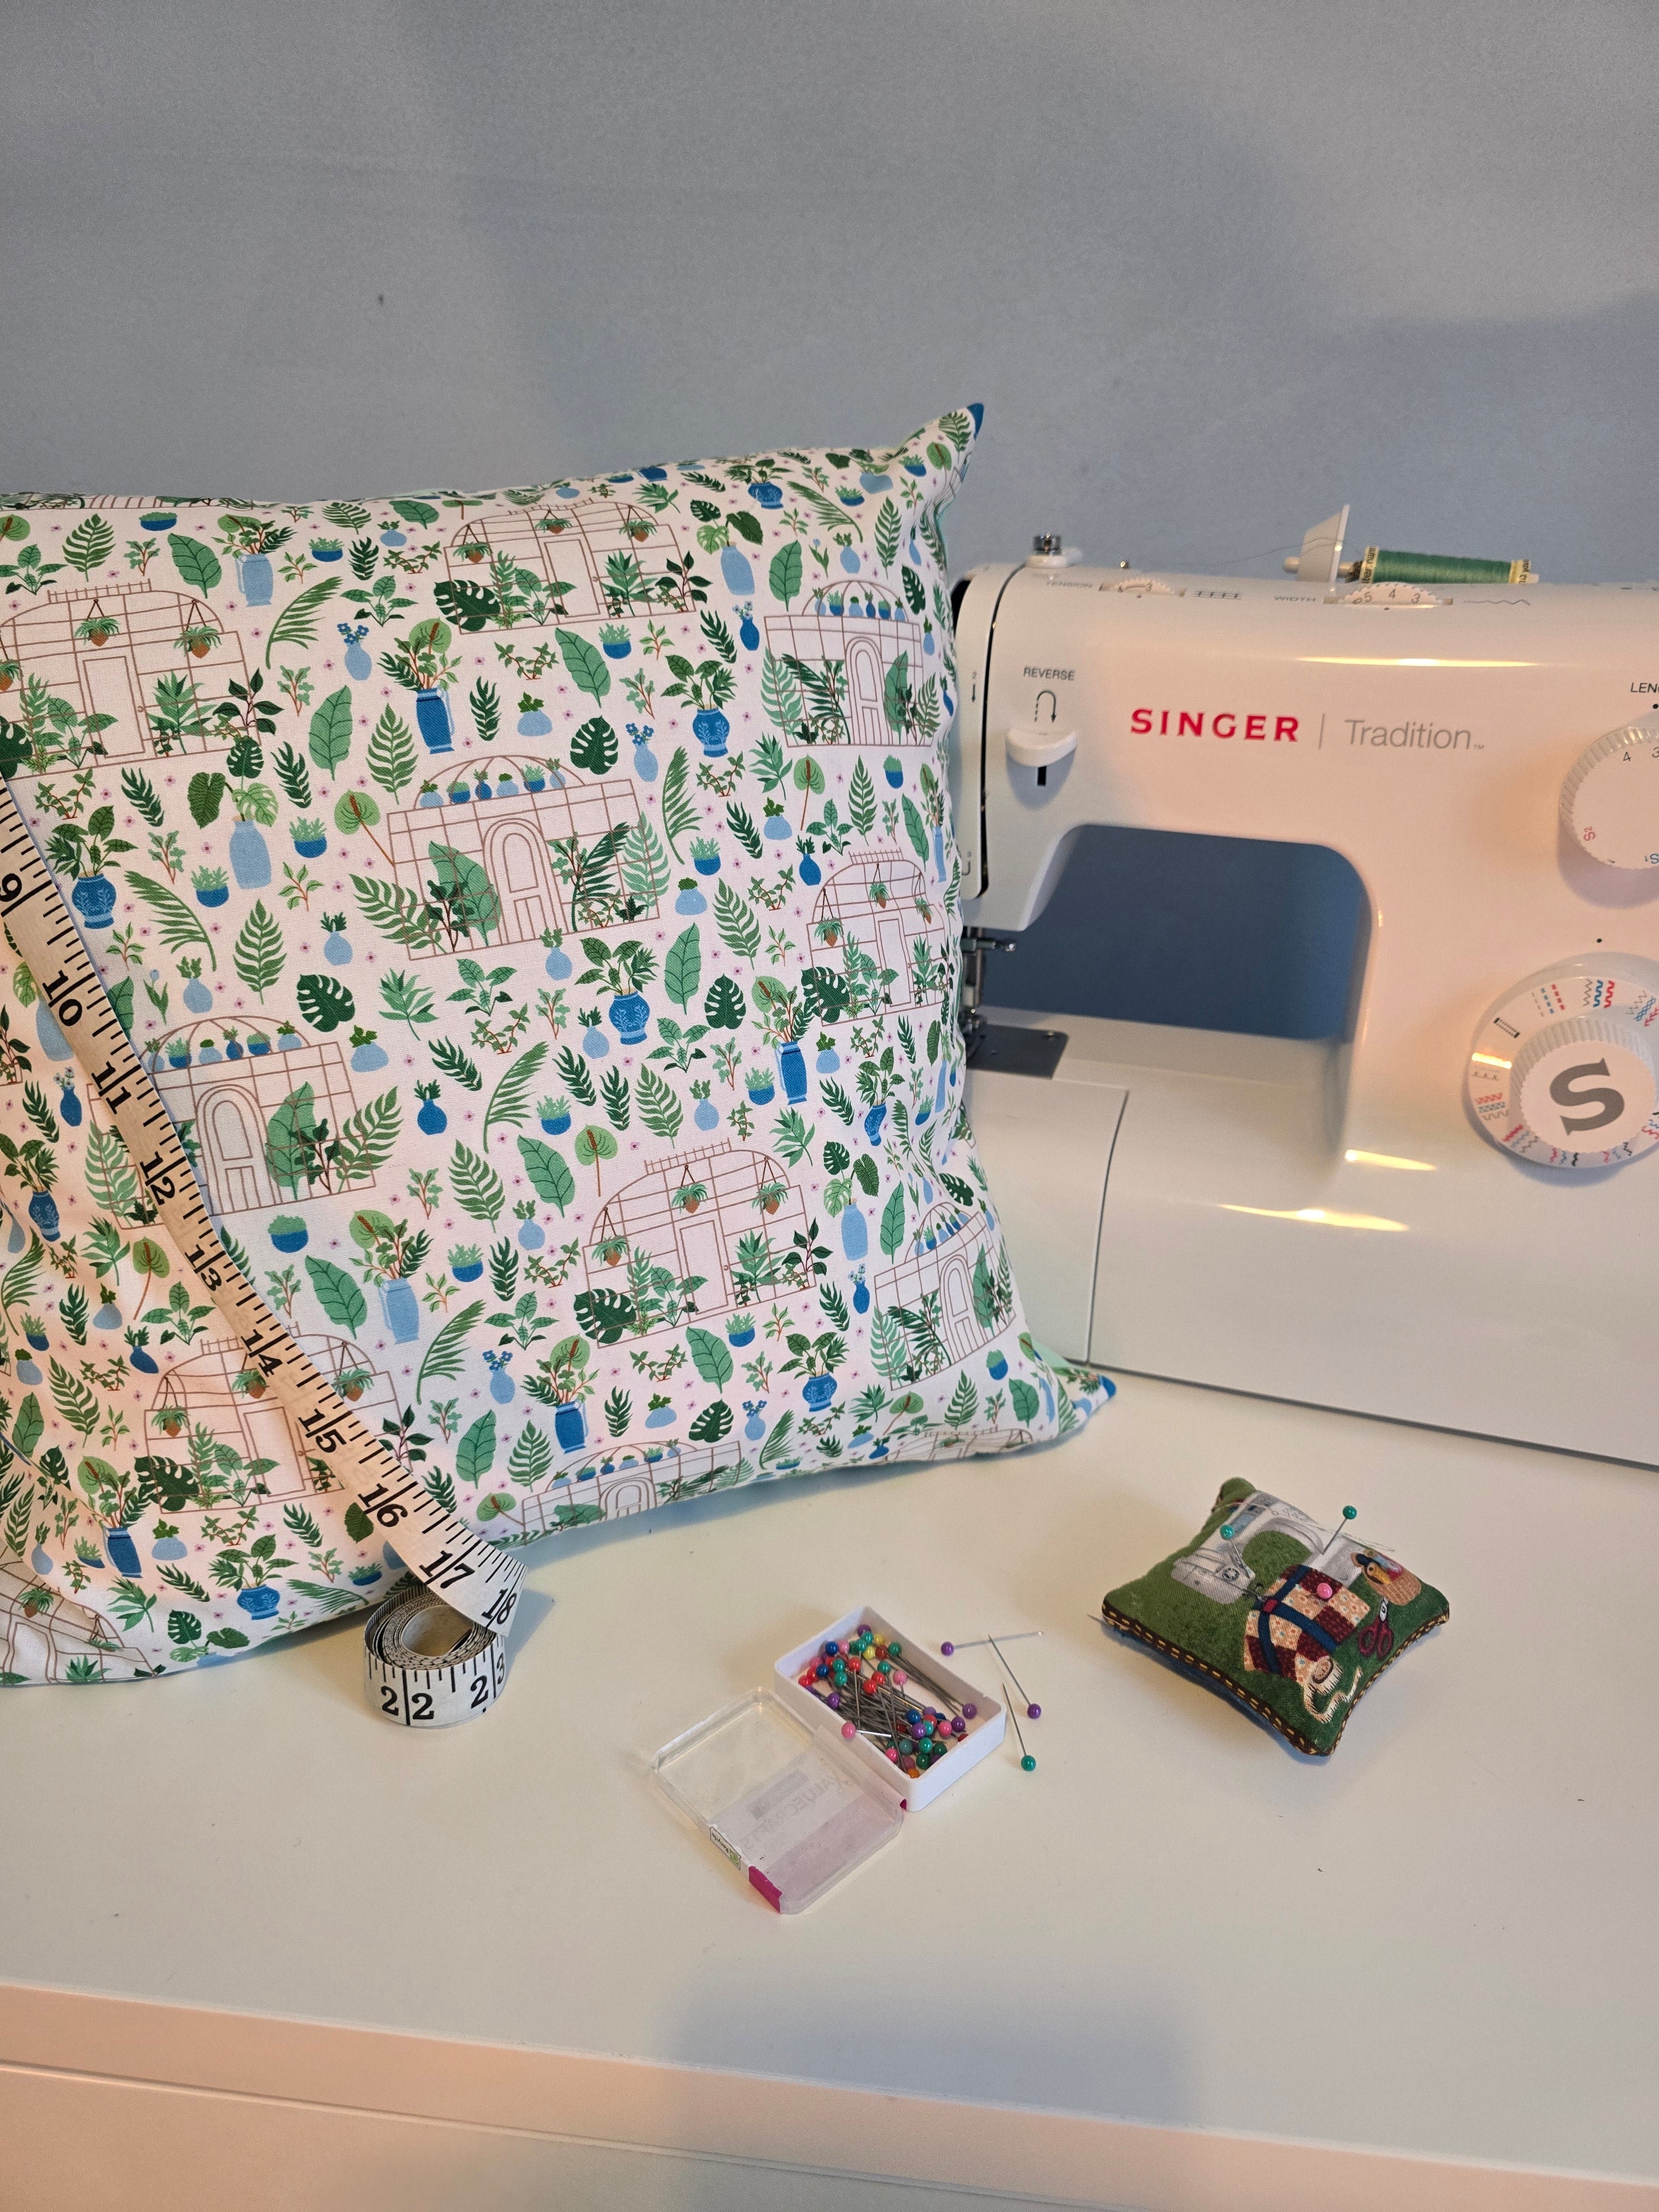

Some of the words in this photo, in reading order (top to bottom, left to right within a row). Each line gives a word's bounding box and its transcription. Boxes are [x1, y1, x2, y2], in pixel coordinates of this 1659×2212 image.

[1364, 592, 1372, 603] 5
[1388, 589, 1396, 599] 4
[1411, 593, 1420, 604] 3
[1023, 667, 1075, 681] REVERSE
[1630, 682, 1659, 693] LEN
[1131, 708, 1298, 742] SINGER
[1344, 719, 1471, 750] Tradition
[1623, 752, 1631, 761] 4
[0, 873, 22, 902] 9
[42, 970, 83, 1027] 10
[91, 1060, 132, 1115] 11
[1550, 1057, 1625, 1136] S
[139, 1151, 176, 1206] 12
[184, 1244, 222, 1292] 13
[241, 1328, 284, 1378] 14
[298, 1408, 347, 1454] 15
[358, 1482, 408, 1527] 16
[419, 1550, 476, 1589] 17
[481, 1588, 517, 1625] 18
[470, 1652, 505, 1709] 23
[380, 1685, 435, 1720] 22
